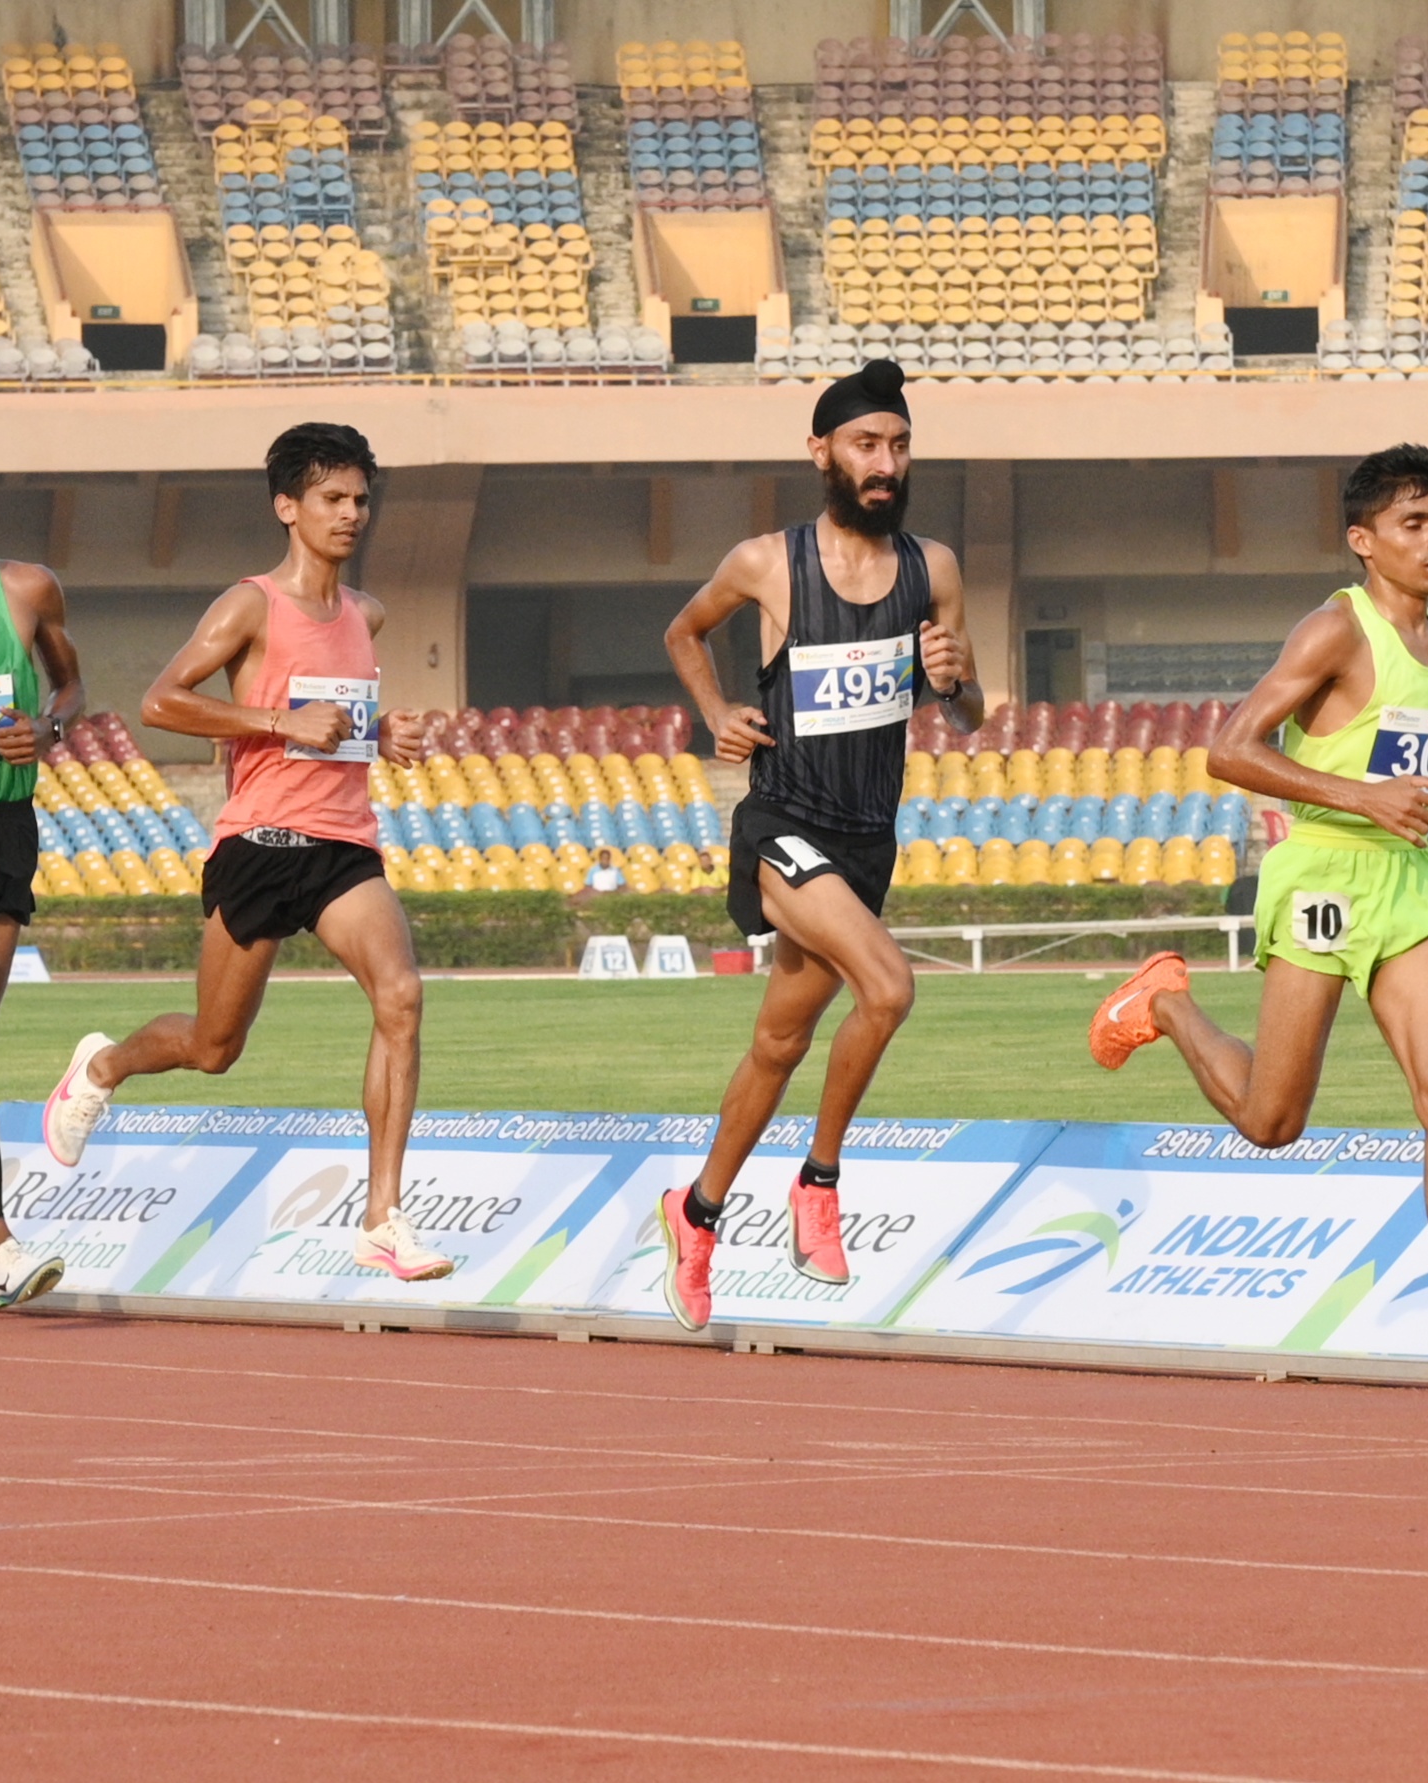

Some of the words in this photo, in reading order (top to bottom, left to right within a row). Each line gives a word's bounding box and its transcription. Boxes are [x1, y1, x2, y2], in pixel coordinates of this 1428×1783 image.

[814, 662, 896, 709] 495
[1302, 902, 1342, 940] 10
[109, 1107, 205, 1134] National
[198, 1108, 276, 1136] Senior
[269, 1109, 369, 1138] Athletics
[408, 1111, 502, 1139] deration
[496, 1113, 651, 1150] Competition
[642, 1115, 714, 1149] 2026,
[1142, 1128, 1216, 1160] 29th
[3, 1170, 177, 1223] Reliance
[316, 1176, 523, 1234] Rliance
[1149, 1215, 1356, 1260] INDIAN
[1107, 1264, 1308, 1299] ATHLETICS
